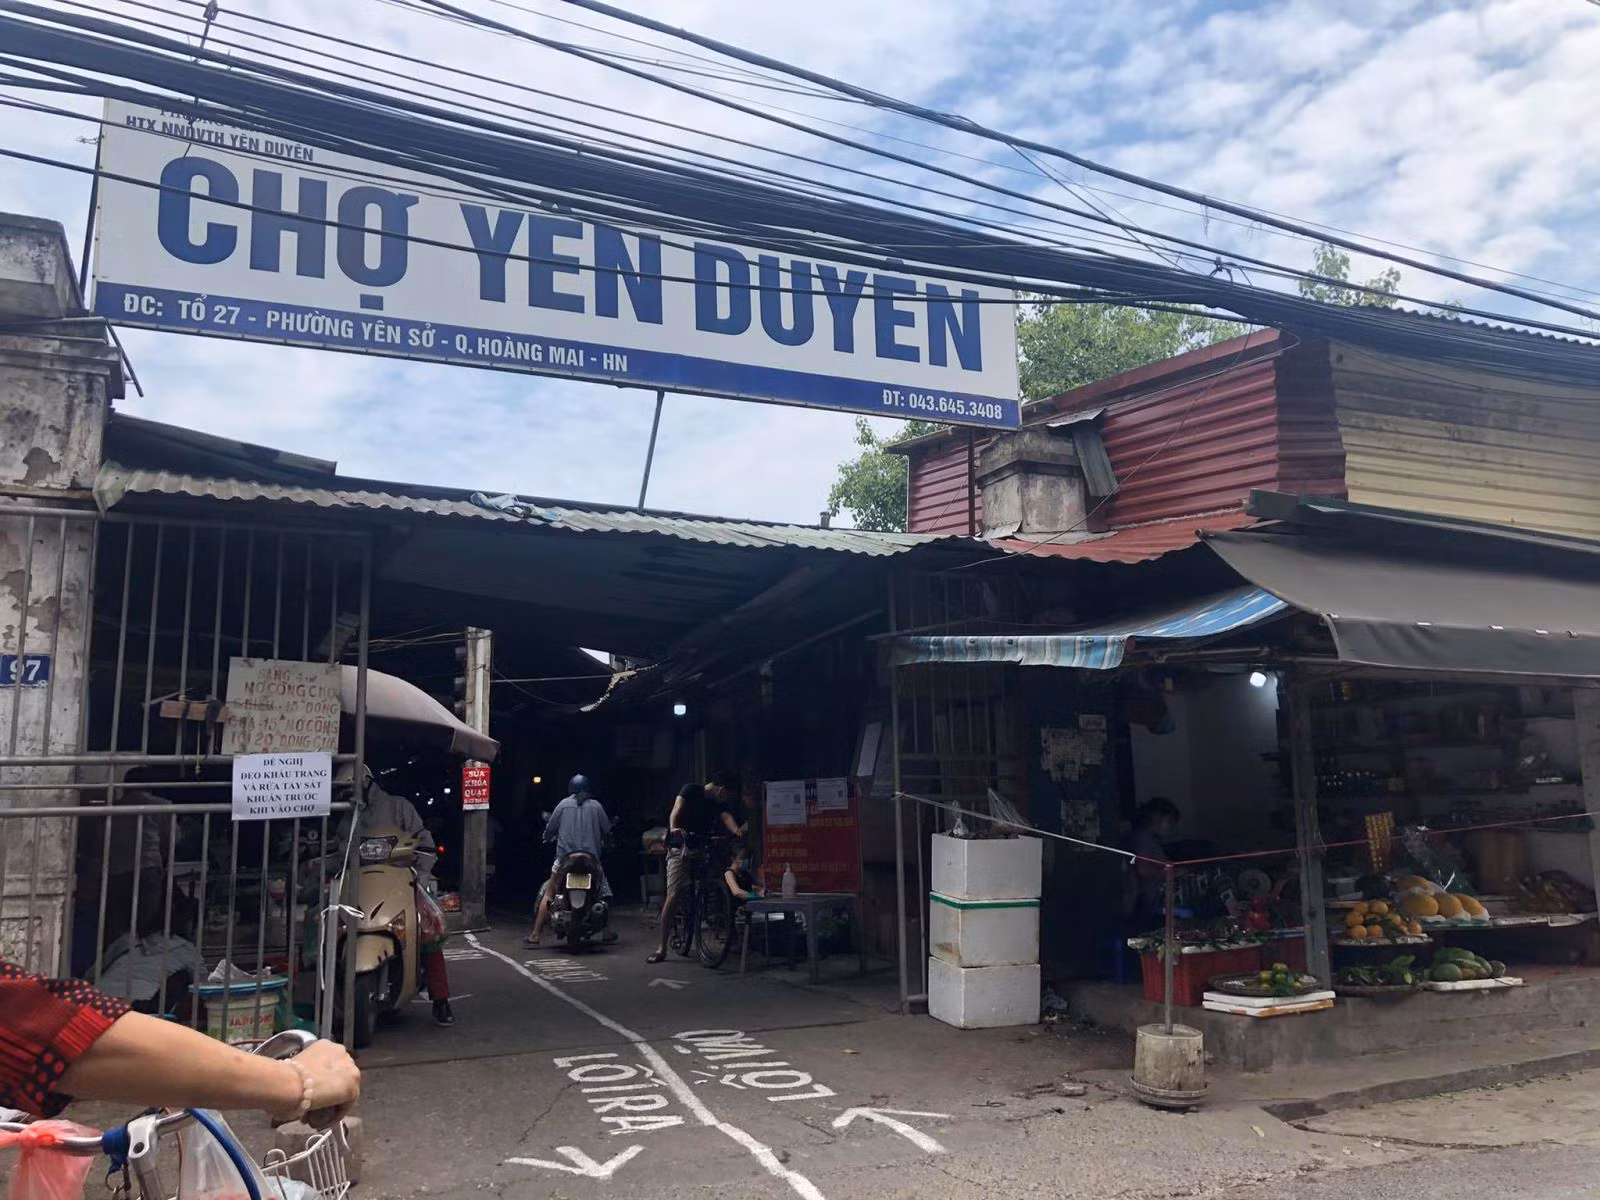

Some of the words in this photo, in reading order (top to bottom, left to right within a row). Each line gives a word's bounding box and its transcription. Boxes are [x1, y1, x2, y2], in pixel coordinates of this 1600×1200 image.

[126, 115, 157, 132] HTX
[230, 132, 260, 154] YÊN
[265, 140, 314, 162] DUYÊN
[157, 156, 419, 311] CHỢ
[459, 199, 664, 325] YÊN
[694, 241, 983, 372] DUYÊN
[123, 293, 164, 317] ĐC:
[178, 294, 208, 321] TỔ
[214, 304, 241, 325] 27
[266, 310, 354, 336] PHƯỜNG
[361, 319, 401, 344] YÊN
[408, 323, 436, 348] SỞ
[478, 336, 543, 362] HOÀNG
[549, 347, 584, 367] MAI
[603, 353, 628, 372] HN
[882, 389, 905, 407] ĐT:
[909, 393, 1002, 420] 043.645.3408
[240, 771, 261, 780] ĐEO
[295, 769, 327, 779] TRANG
[279, 757, 303, 767] NGHỊ
[242, 781, 256, 791] VÀ
[283, 781, 301, 790] TAY
[304, 780, 322, 790] SÁT
[250, 806, 268, 815] KHI
[271, 804, 291, 814] VÀO
[293, 804, 315, 814] CHỢ
[587, 1094, 685, 1135] RA
